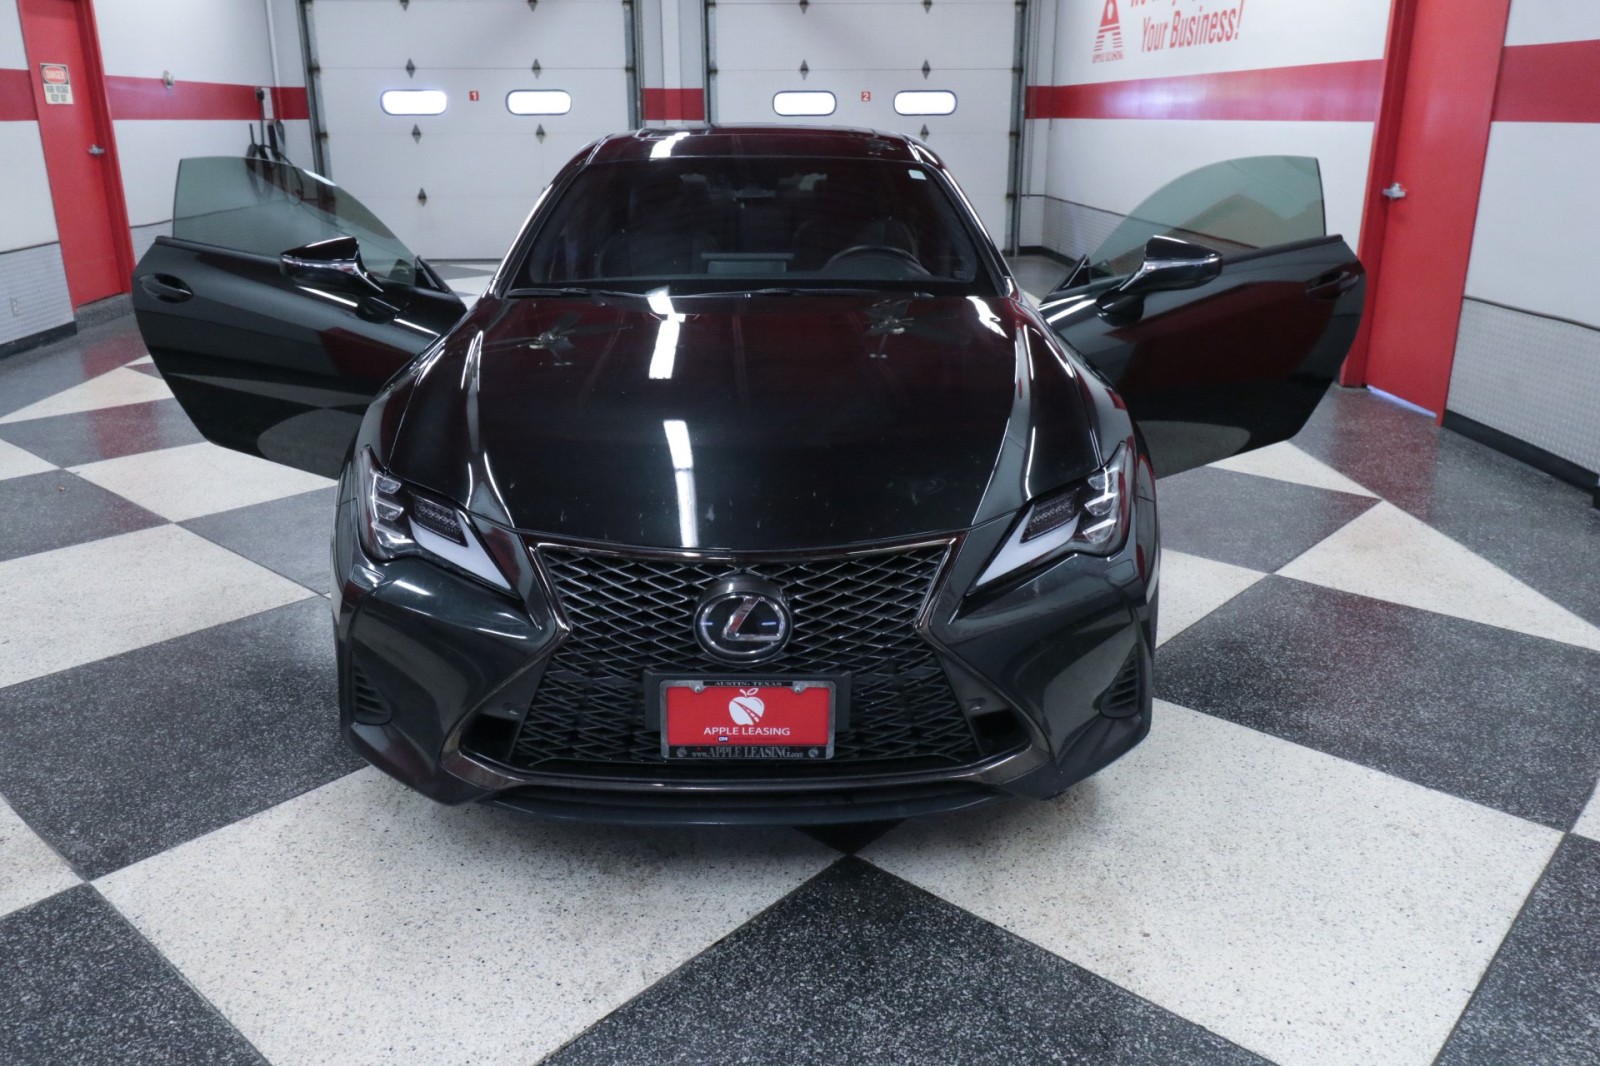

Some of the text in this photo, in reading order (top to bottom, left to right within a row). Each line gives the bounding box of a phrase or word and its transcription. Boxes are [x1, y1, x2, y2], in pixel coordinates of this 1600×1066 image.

[1141, 0, 1244, 52] Your Business!
[45, 70, 65, 79] DANGER
[703, 726, 791, 736] APPLE LEASING
